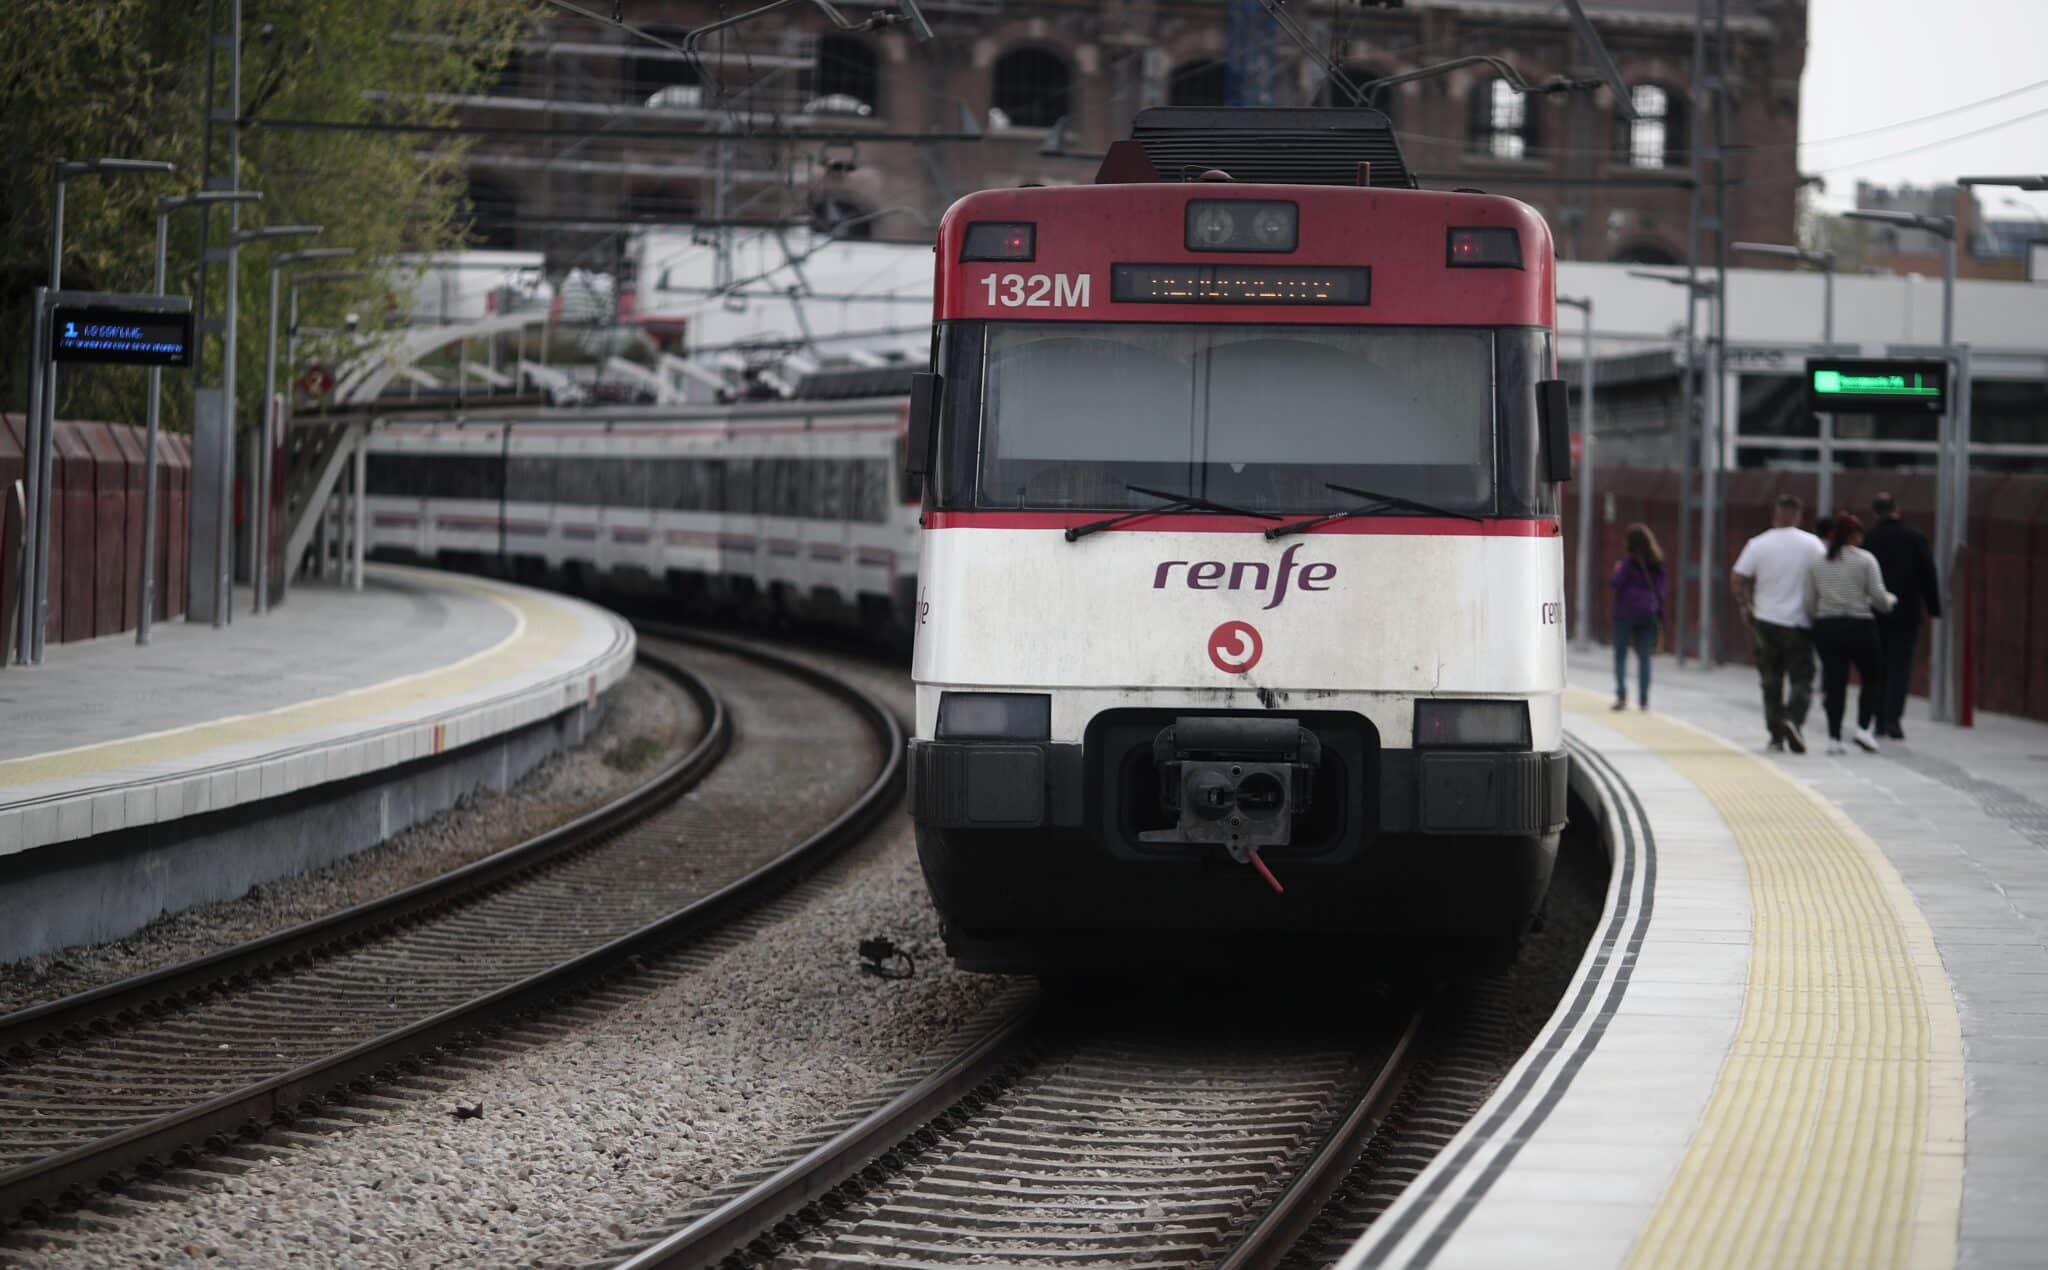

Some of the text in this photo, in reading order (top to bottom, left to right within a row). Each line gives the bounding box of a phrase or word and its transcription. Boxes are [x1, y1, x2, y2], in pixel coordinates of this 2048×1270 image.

[980, 273, 1091, 307] 132M
[64, 321, 79, 338] 1
[1153, 542, 1337, 610] renfe
